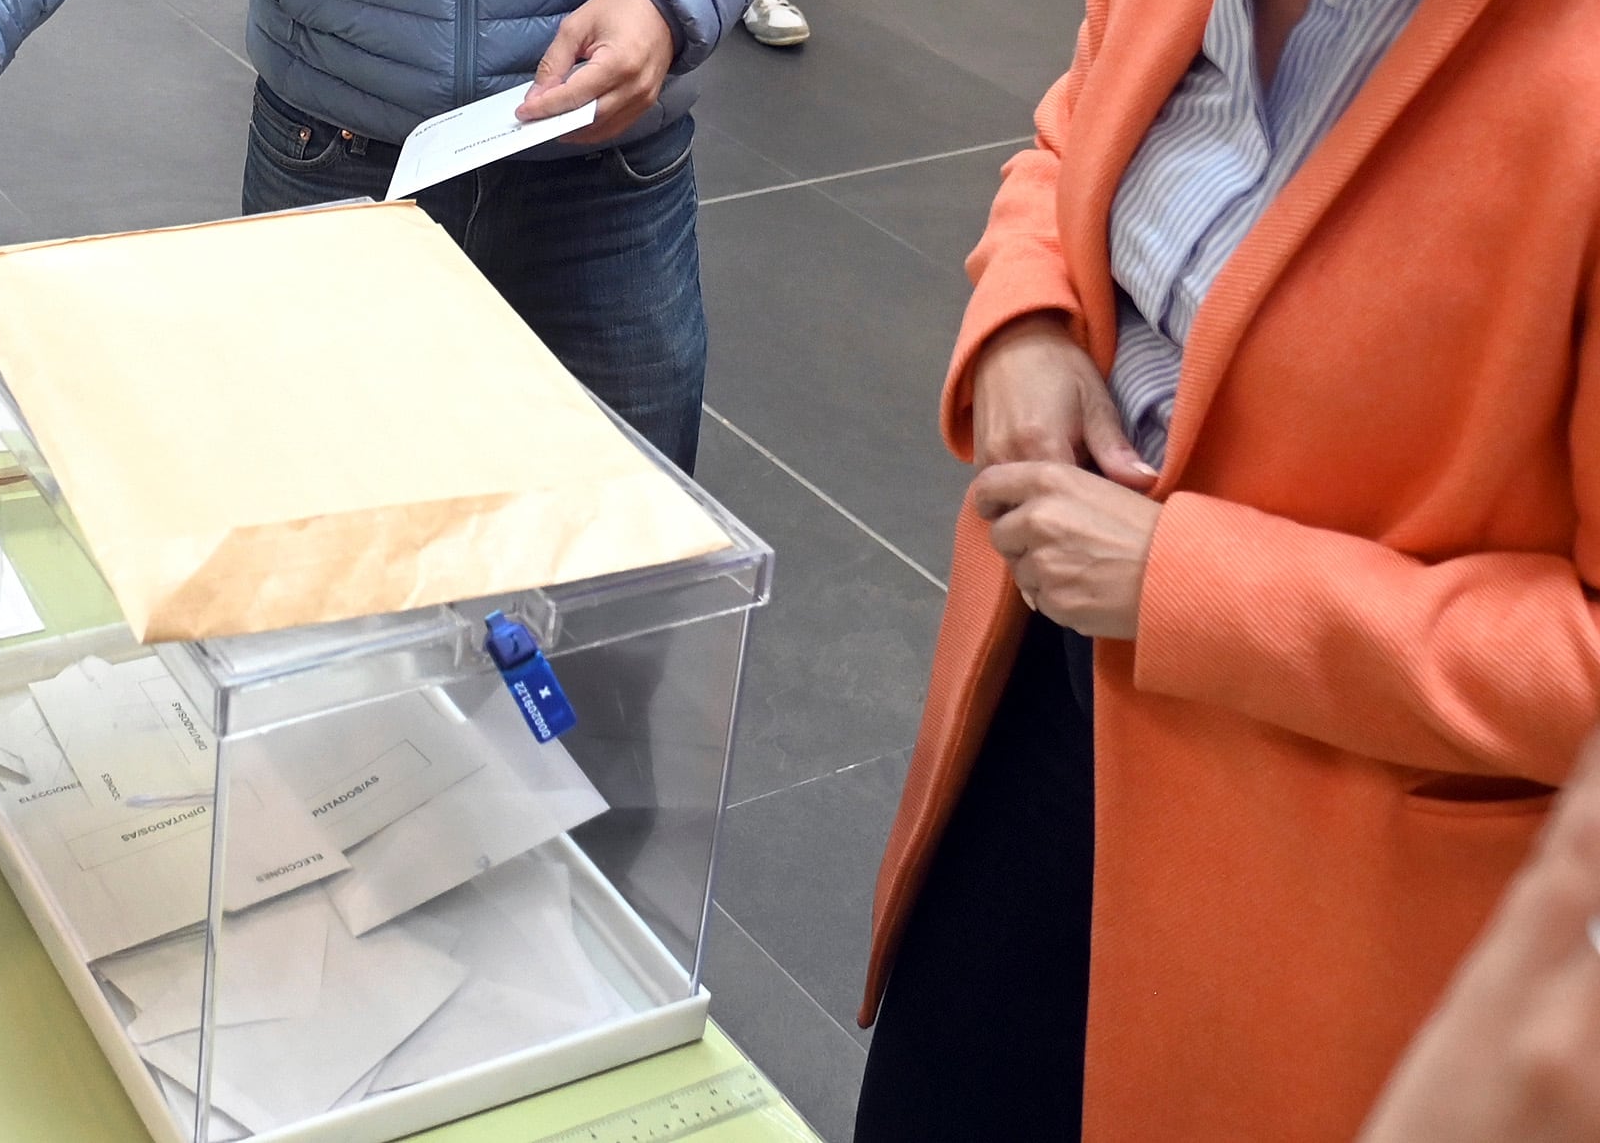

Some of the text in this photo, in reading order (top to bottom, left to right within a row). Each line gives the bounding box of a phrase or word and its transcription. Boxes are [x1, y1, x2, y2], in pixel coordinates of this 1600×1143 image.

[311, 775, 380, 818] PUTADOS/AS
[120, 805, 206, 843] DIPUTADOS/AS
[256, 852, 324, 883] ELECCIONES
